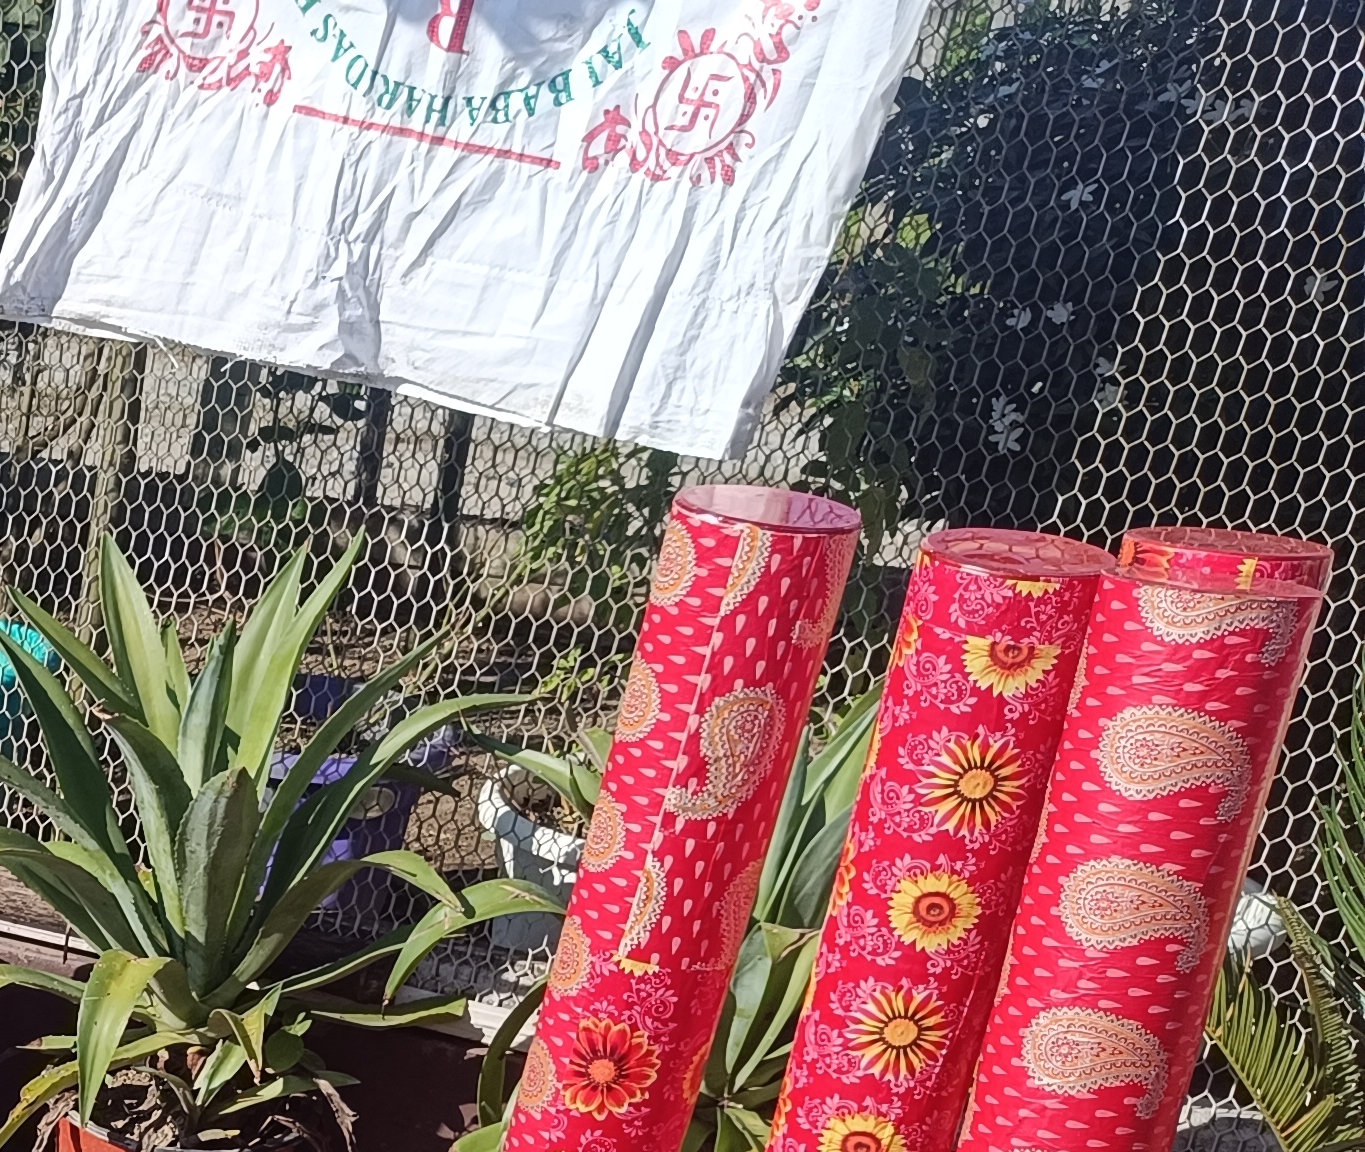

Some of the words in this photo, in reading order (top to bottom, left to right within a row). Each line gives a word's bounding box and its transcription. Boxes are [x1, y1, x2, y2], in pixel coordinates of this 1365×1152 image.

[310, 13, 453, 127] HARIDAS
[584, 9, 652, 88] JAI
[462, 68, 575, 127] BABA
